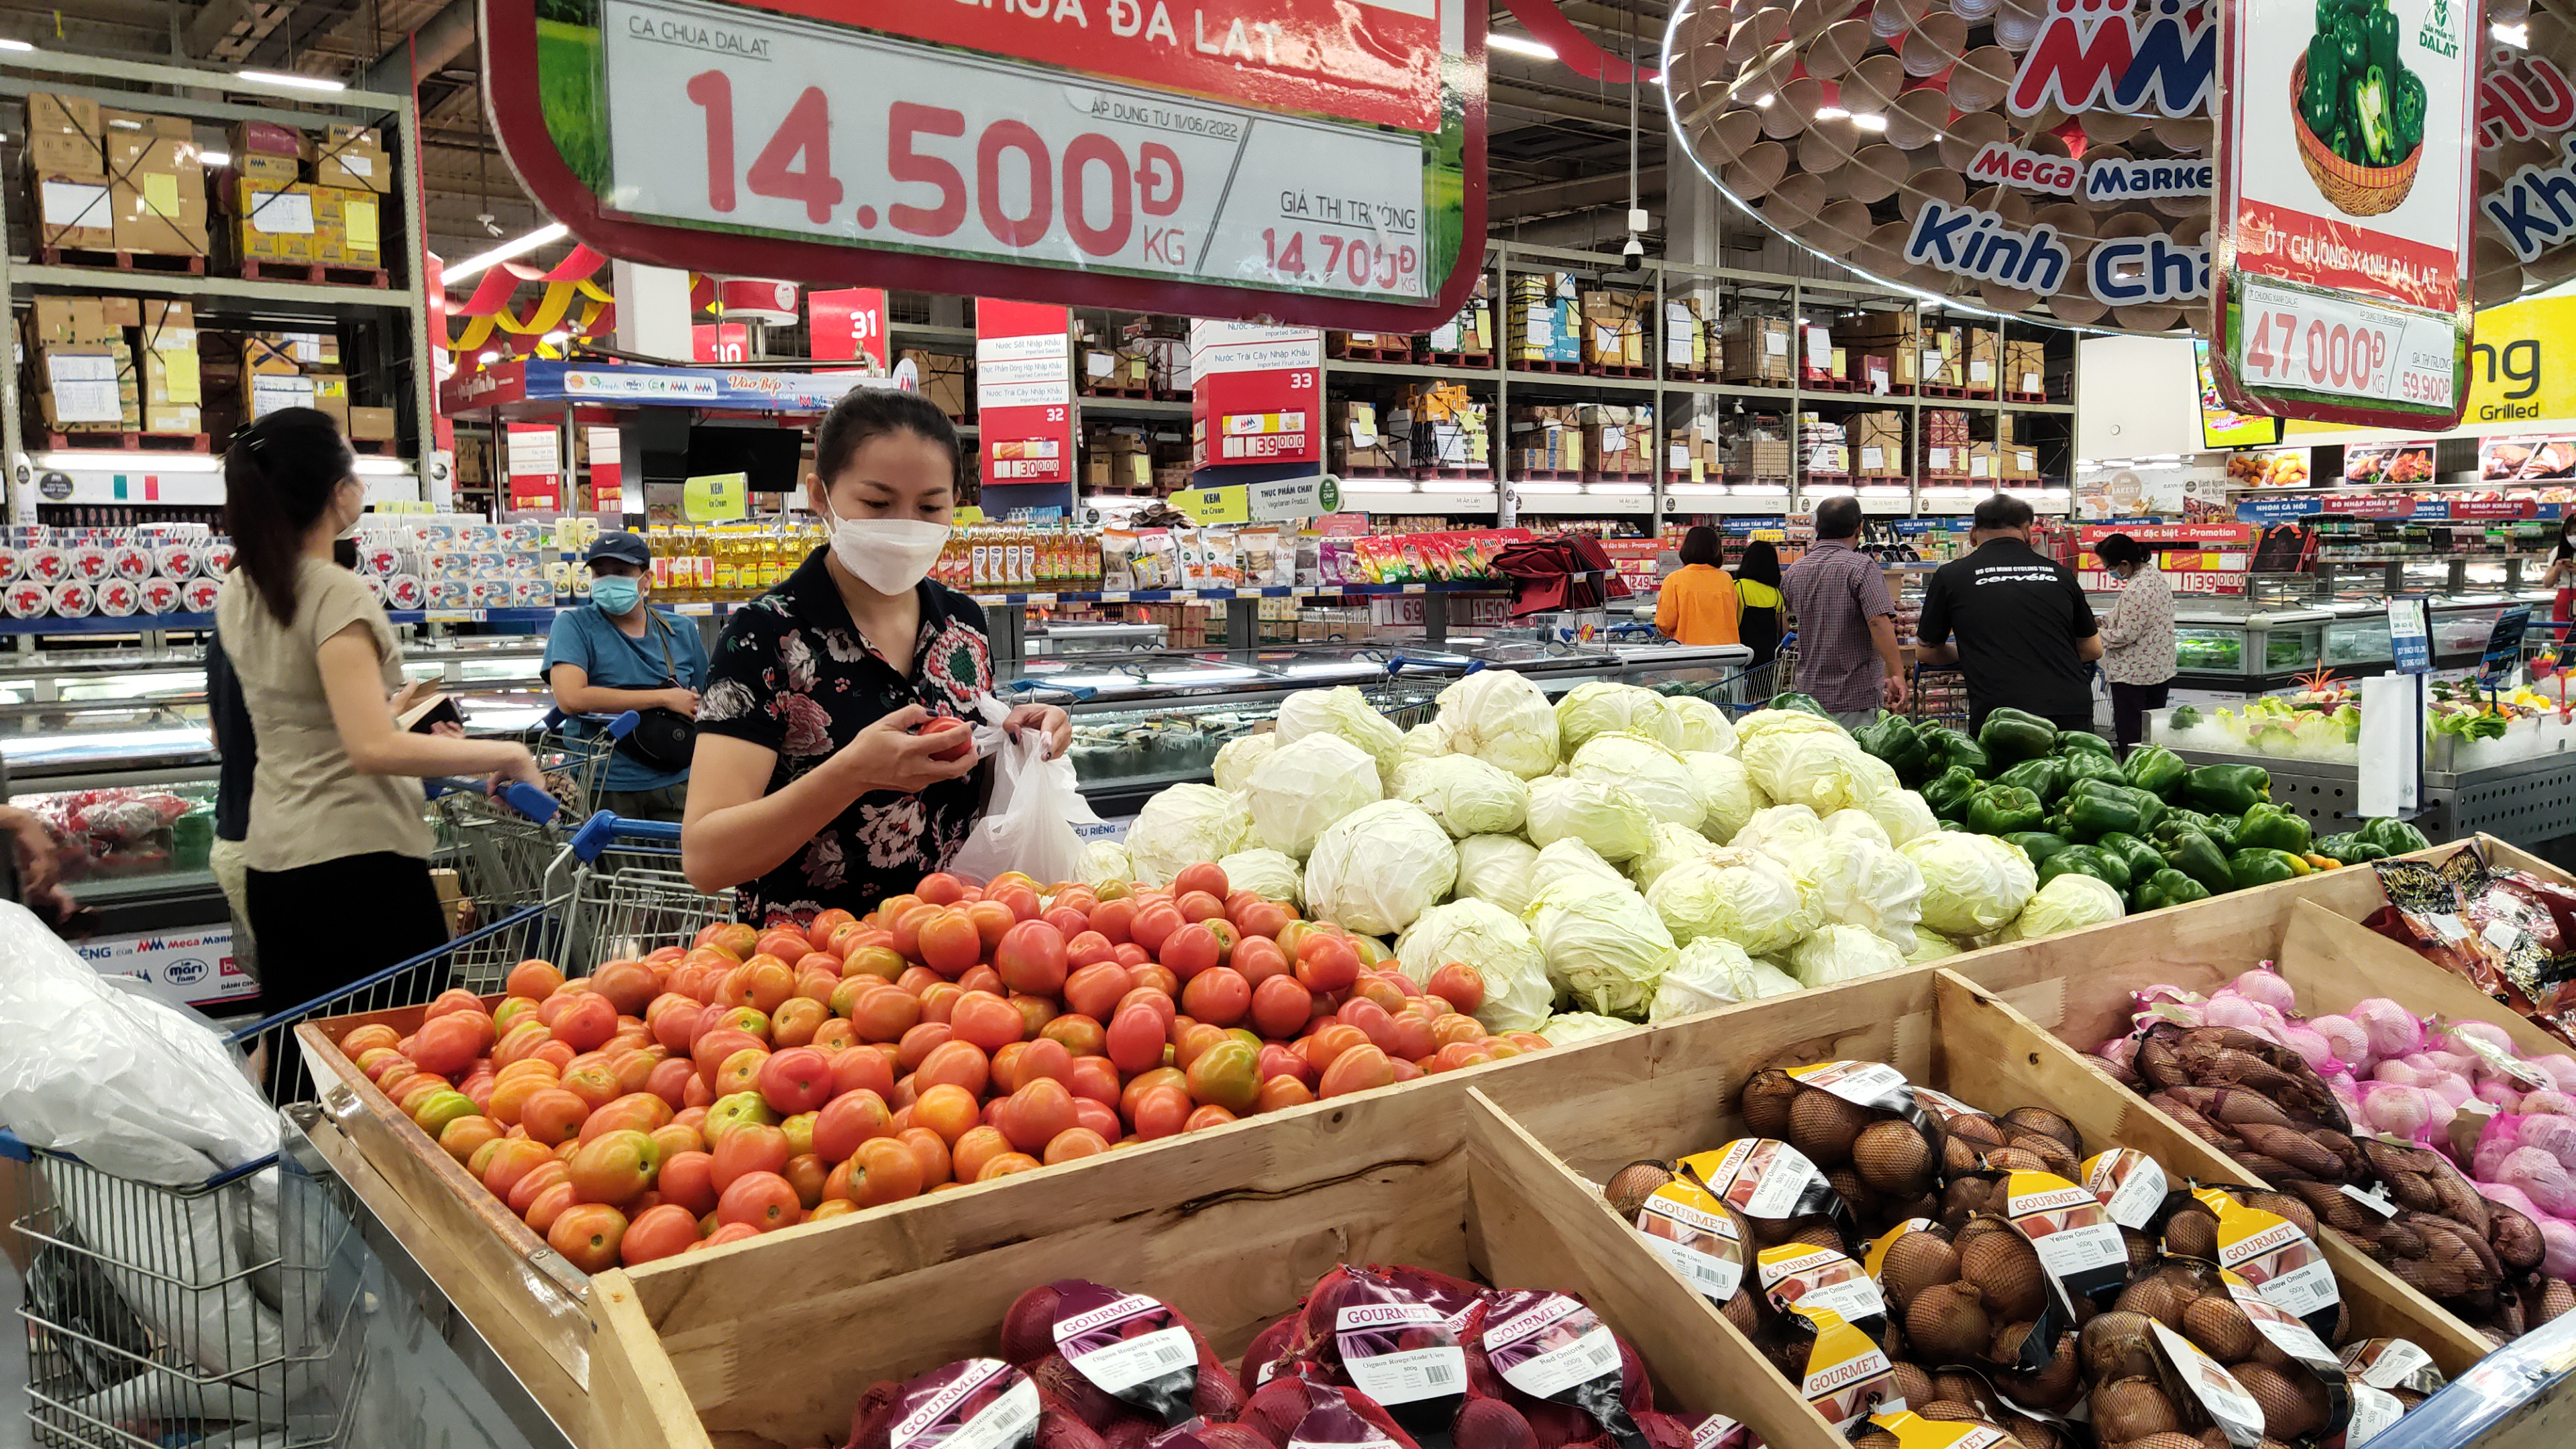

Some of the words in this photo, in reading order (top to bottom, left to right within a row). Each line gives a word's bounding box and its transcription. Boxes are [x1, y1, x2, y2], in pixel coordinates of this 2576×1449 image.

[661, 21, 709, 46] CHUA
[715, 30, 770, 56] DALAT
[1195, 8, 1282, 70] LẠT
[2419, 31, 2459, 60] DALAT
[1175, 114, 1238, 138] 11/06/2022
[2089, 166, 2212, 195] Marke
[1316, 195, 1341, 223] THỊ
[2487, 172, 2576, 254] Kh
[1144, 225, 1185, 266] KG
[1911, 205, 2063, 288] Kính
[2351, 249, 2387, 278] XANH
[1401, 277, 1417, 292] KG
[850, 309, 877, 339] 31
[1215, 354, 1234, 362] Nước
[1237, 352, 1250, 361] Trái
[1252, 352, 1268, 361] Cây
[728, 374, 757, 390] Vào
[759, 376, 782, 396] Bếp
[1291, 372, 1313, 389] 33
[2372, 373, 2384, 393] KG
[1046, 408, 1064, 422] 32
[2480, 402, 2539, 421] Grilled
[710, 482, 724, 495] KEM
[1203, 492, 1220, 504] KEM
[1260, 489, 1277, 499] THỰC
[1297, 484, 1313, 493] CHAY
[2112, 486, 2139, 495] BAKERY
[714, 499, 727, 508] Cream
[1209, 506, 1225, 515] Cream
[1267, 499, 1290, 509] Vegetarian
[1291, 497, 1309, 506] Product
[2281, 502, 2291, 511] CÁ
[2126, 529, 2141, 537] mãi
[2143, 528, 2159, 539] đặc
[2161, 528, 2179, 539] biệt
[2190, 528, 2237, 537] Promotion
[1975, 574, 2058, 586] cervélo
[1713, 1141, 1750, 1189] GOURMET
[1756, 1177, 1769, 1196] Yellow
[1768, 1159, 1782, 1179] Onions
[1775, 1171, 1788, 1184] 500g
[2112, 1186, 2129, 1205] Yellow
[2127, 1170, 2143, 1187] Onions
[2015, 1190, 2084, 1211] GOURMET
[2133, 1185, 2146, 1197] 500g
[1654, 1199, 1728, 1232] GOURMET
[2049, 1233, 2074, 1244] Yellow
[2074, 1228, 2100, 1237] Onions
[2076, 1240, 2093, 1249] 500g
[2226, 1225, 2293, 1260] GOURMET
[1688, 1254, 1702, 1264] Uien
[1766, 1252, 1833, 1279] GOURMET
[2262, 1280, 2286, 1293] Yellow
[2286, 1269, 2311, 1284] Onions
[2289, 1285, 2305, 1296] 500g
[1805, 1290, 1829, 1303] Yellow
[1829, 1282, 1854, 1295] Onions
[1831, 1295, 1848, 1303] 500g
[1063, 1297, 1145, 1332] GOURMET
[1347, 1307, 1429, 1324] GOURMET
[1491, 1301, 1567, 1344] GOURMET
[1092, 1350, 1116, 1362] Oignon
[1117, 1340, 1155, 1356] Rouge/Rode
[1133, 1350, 1148, 1359] 500g
[1539, 1354, 1556, 1365] Red
[1556, 1343, 1585, 1359] Onions
[1362, 1359, 1387, 1369] Oignon
[1389, 1354, 1429, 1366] Rouge/Rode
[1562, 1356, 1581, 1368] 500g
[1810, 1354, 1879, 1392] GOURMET
[901, 1362, 990, 1436] GOURMET
[2368, 1410, 2377, 1424] 500g
[2351, 1414, 2361, 1441] Yellow
